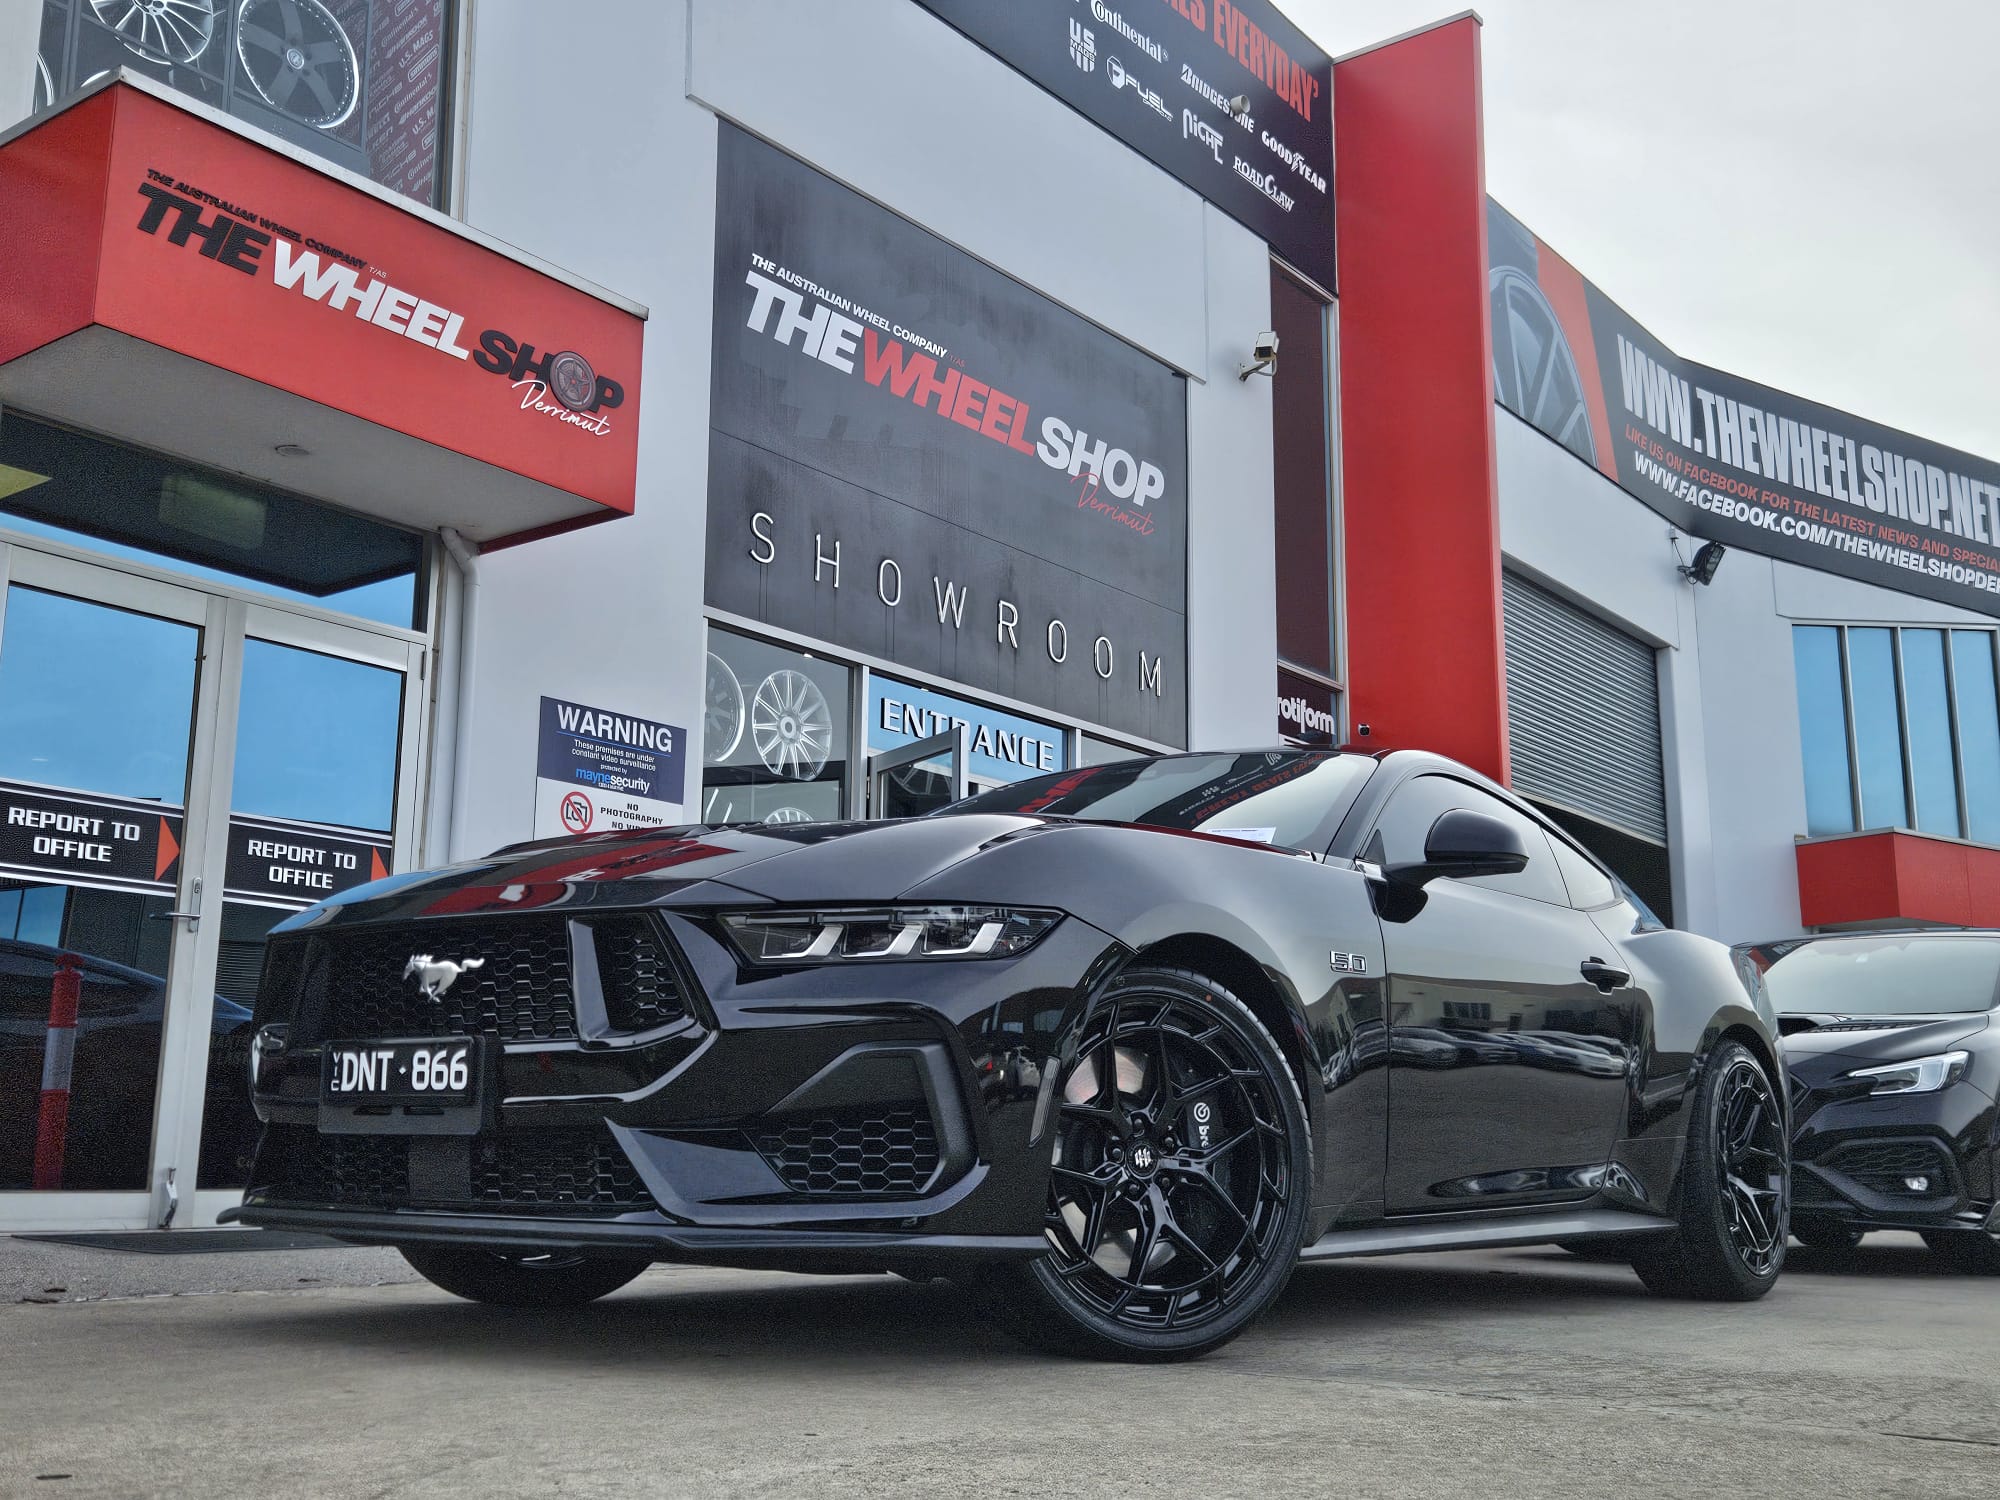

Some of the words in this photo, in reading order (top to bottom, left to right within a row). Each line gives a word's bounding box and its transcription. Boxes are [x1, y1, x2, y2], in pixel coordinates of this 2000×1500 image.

[1091, 0, 1162, 63] Continental
[1261, 130, 1327, 194] GOODYEAR
[148, 168, 173, 187] THE
[173, 181, 258, 223] AUSTRALIAN
[259, 216, 303, 243] WHEEL
[304, 237, 367, 269] COMPANY
[137, 182, 272, 276] THE
[273, 238, 470, 361] WHEEL
[472, 329, 625, 413] SHOP
[751, 252, 776, 274] THE
[776, 267, 851, 312] AUSTRALIAN
[853, 304, 891, 332] WHEEL
[892, 325, 948, 358] COMPANY
[511, 379, 611, 436] Derrimut
[745, 270, 865, 375] THE
[863, 327, 1036, 457] WHEEL
[1036, 416, 1165, 507] SHOP
[1070, 473, 1155, 536] Derrimut
[1625, 423, 1648, 448] LIKE
[1650, 442, 1664, 462] US
[1665, 451, 1683, 473] ON
[1683, 461, 1761, 502] FACEBOOK
[1761, 490, 1790, 511] FOR
[1793, 499, 1821, 520] THE
[1822, 508, 1876, 536] LATEST
[1877, 525, 1919, 549] NEWS
[1920, 537, 1950, 558] AND
[750, 512, 1162, 698] SHOWROOM
[557, 703, 673, 753] WARNING
[1277, 696, 1336, 735] rotiform
[571, 748, 600, 760] constant
[601, 754, 618, 765] video
[574, 738, 594, 751] These
[595, 744, 624, 758] premises
[625, 751, 636, 760] are
[636, 754, 655, 764] under
[8, 806, 104, 836] REPORT
[111, 821, 140, 841] TO
[600, 806, 664, 825] PHOTOGRAPHY
[611, 821, 624, 830] NO
[627, 803, 639, 812] NO
[33, 836, 113, 863] OFFICE
[247, 839, 326, 866] REPORT
[332, 852, 357, 870] TO
[268, 865, 334, 889] OFFICE
[411, 1049, 468, 1091] 866
